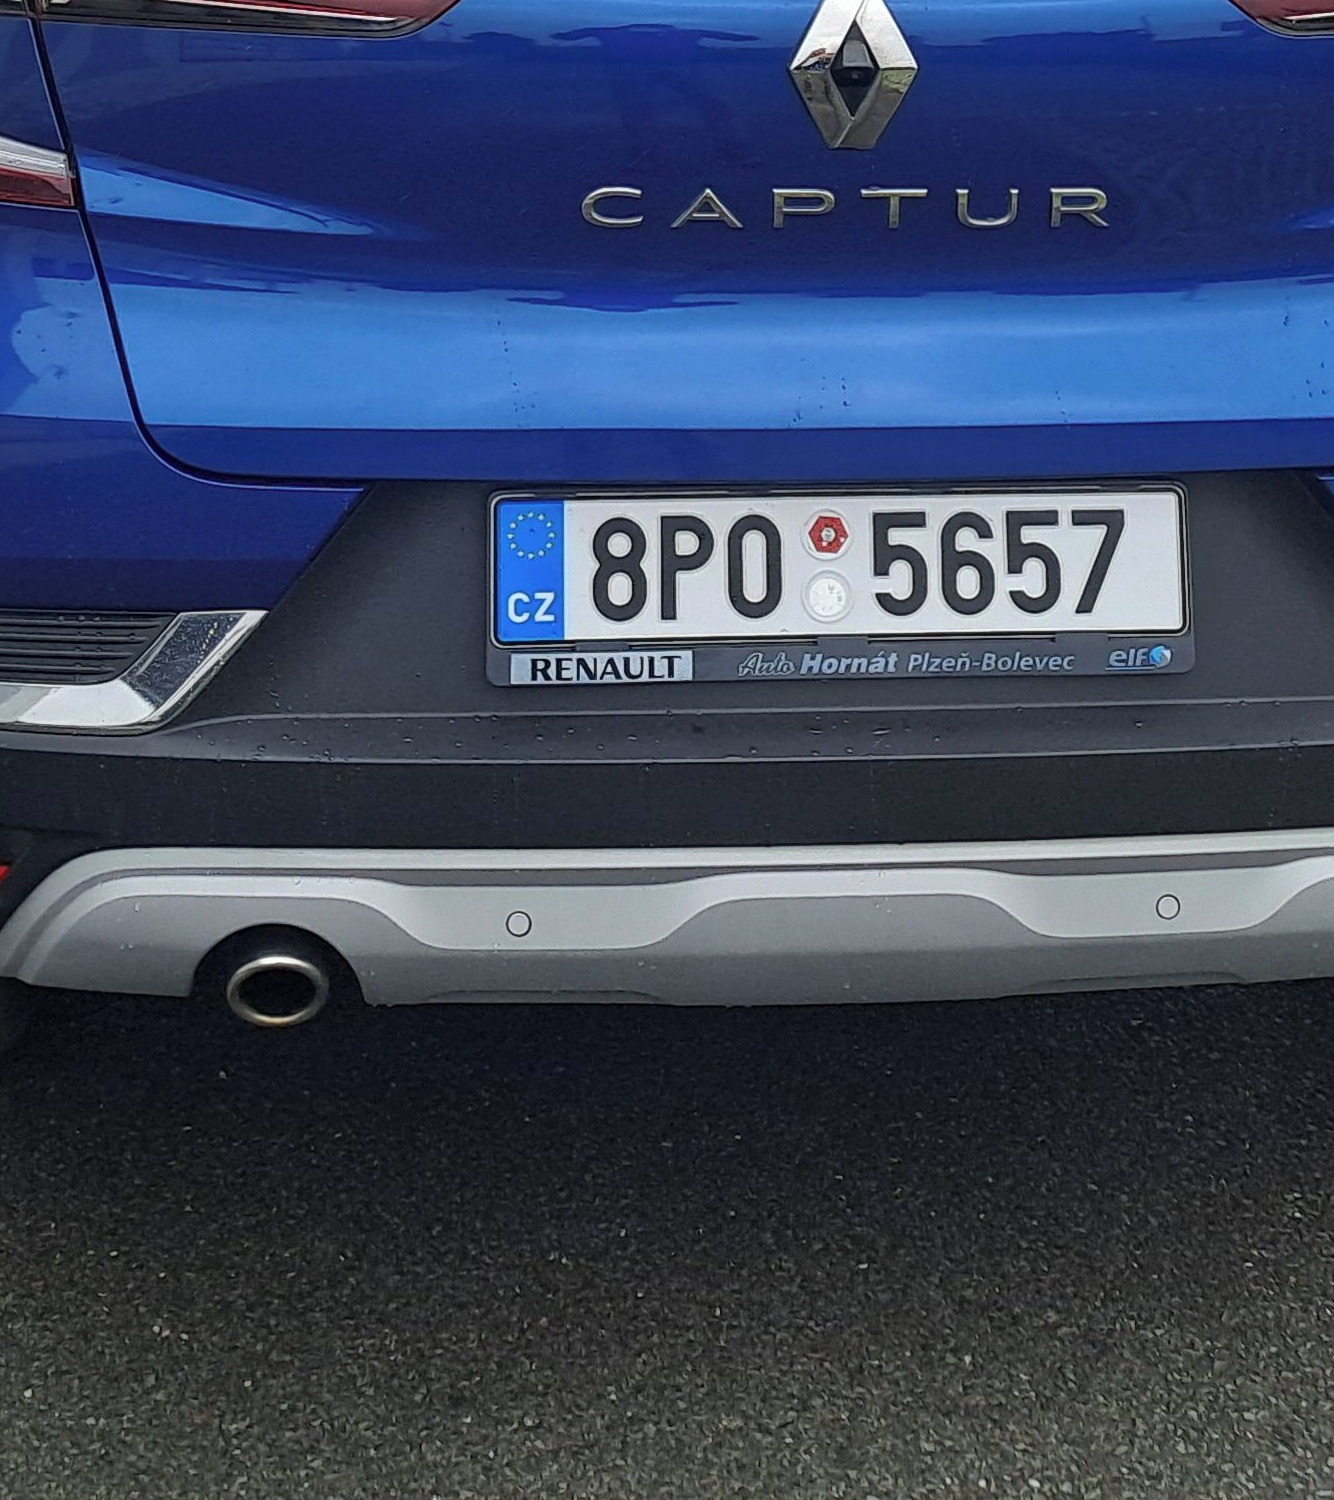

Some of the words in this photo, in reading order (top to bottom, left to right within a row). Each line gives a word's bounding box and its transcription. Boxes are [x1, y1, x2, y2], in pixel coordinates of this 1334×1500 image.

[581, 186, 1110, 229] CAPTUR
[592, 514, 782, 622] 8P0
[872, 508, 1125, 618] 5657
[507, 591, 555, 623] CZ
[531, 655, 682, 681] RENAULT
[737, 652, 795, 677] Auto
[799, 651, 898, 675] Hornát
[908, 651, 1075, 673] Plzeň-Bolevec
[1108, 648, 1149, 670] elf
